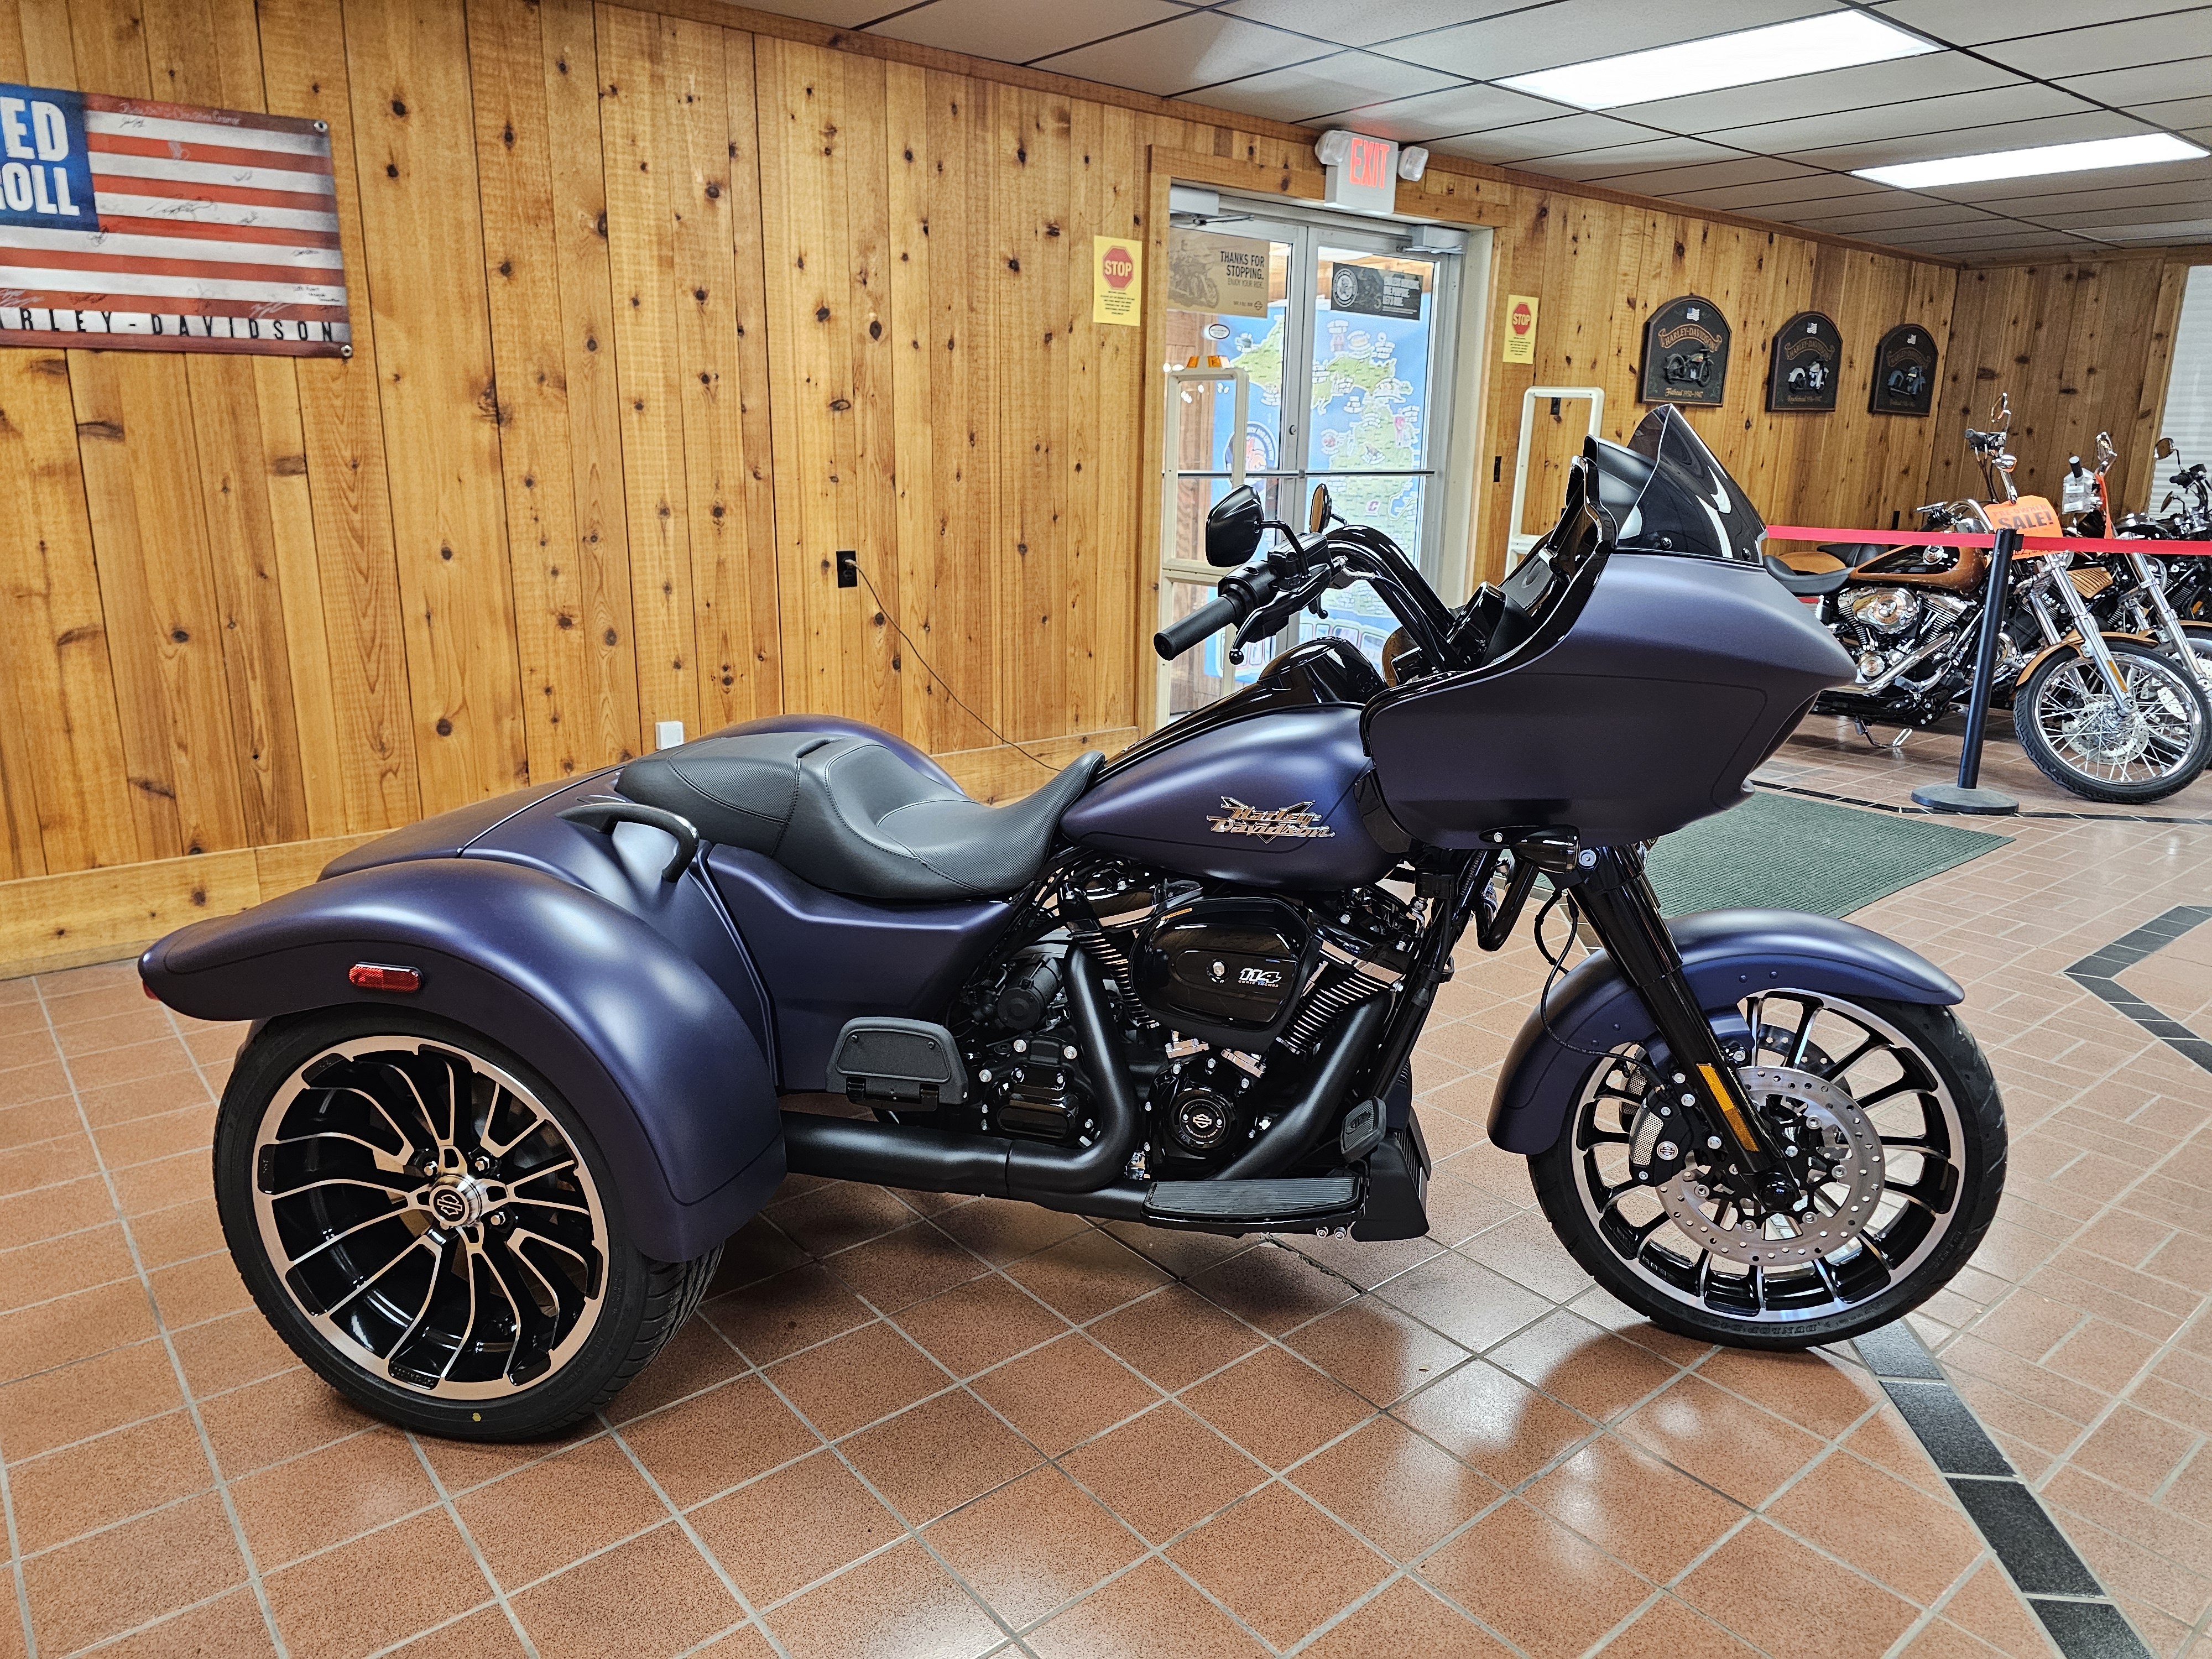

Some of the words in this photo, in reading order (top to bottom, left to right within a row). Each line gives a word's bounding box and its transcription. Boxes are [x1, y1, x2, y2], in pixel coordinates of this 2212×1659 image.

[1349, 138, 1390, 189] EXIT
[0, 162, 80, 216] OLL
[1104, 259, 1133, 277] STOP
[1220, 251, 1249, 265] THANKS
[1250, 254, 1265, 268] FOR
[1226, 264, 1264, 280] STOPPING.
[0, 306, 333, 342] RLEY-DAVIDSON
[1512, 313, 1531, 326] STOP
[1665, 327, 1715, 350] HARLEY-DAVIDSON
[1992, 504, 2048, 517] PRE-OWNED
[1997, 510, 2054, 530] SALE!
[1206, 815, 1336, 837] Davidson
[1239, 968, 1282, 984] 114
[1747, 1324, 1817, 1335] DUNLOP
